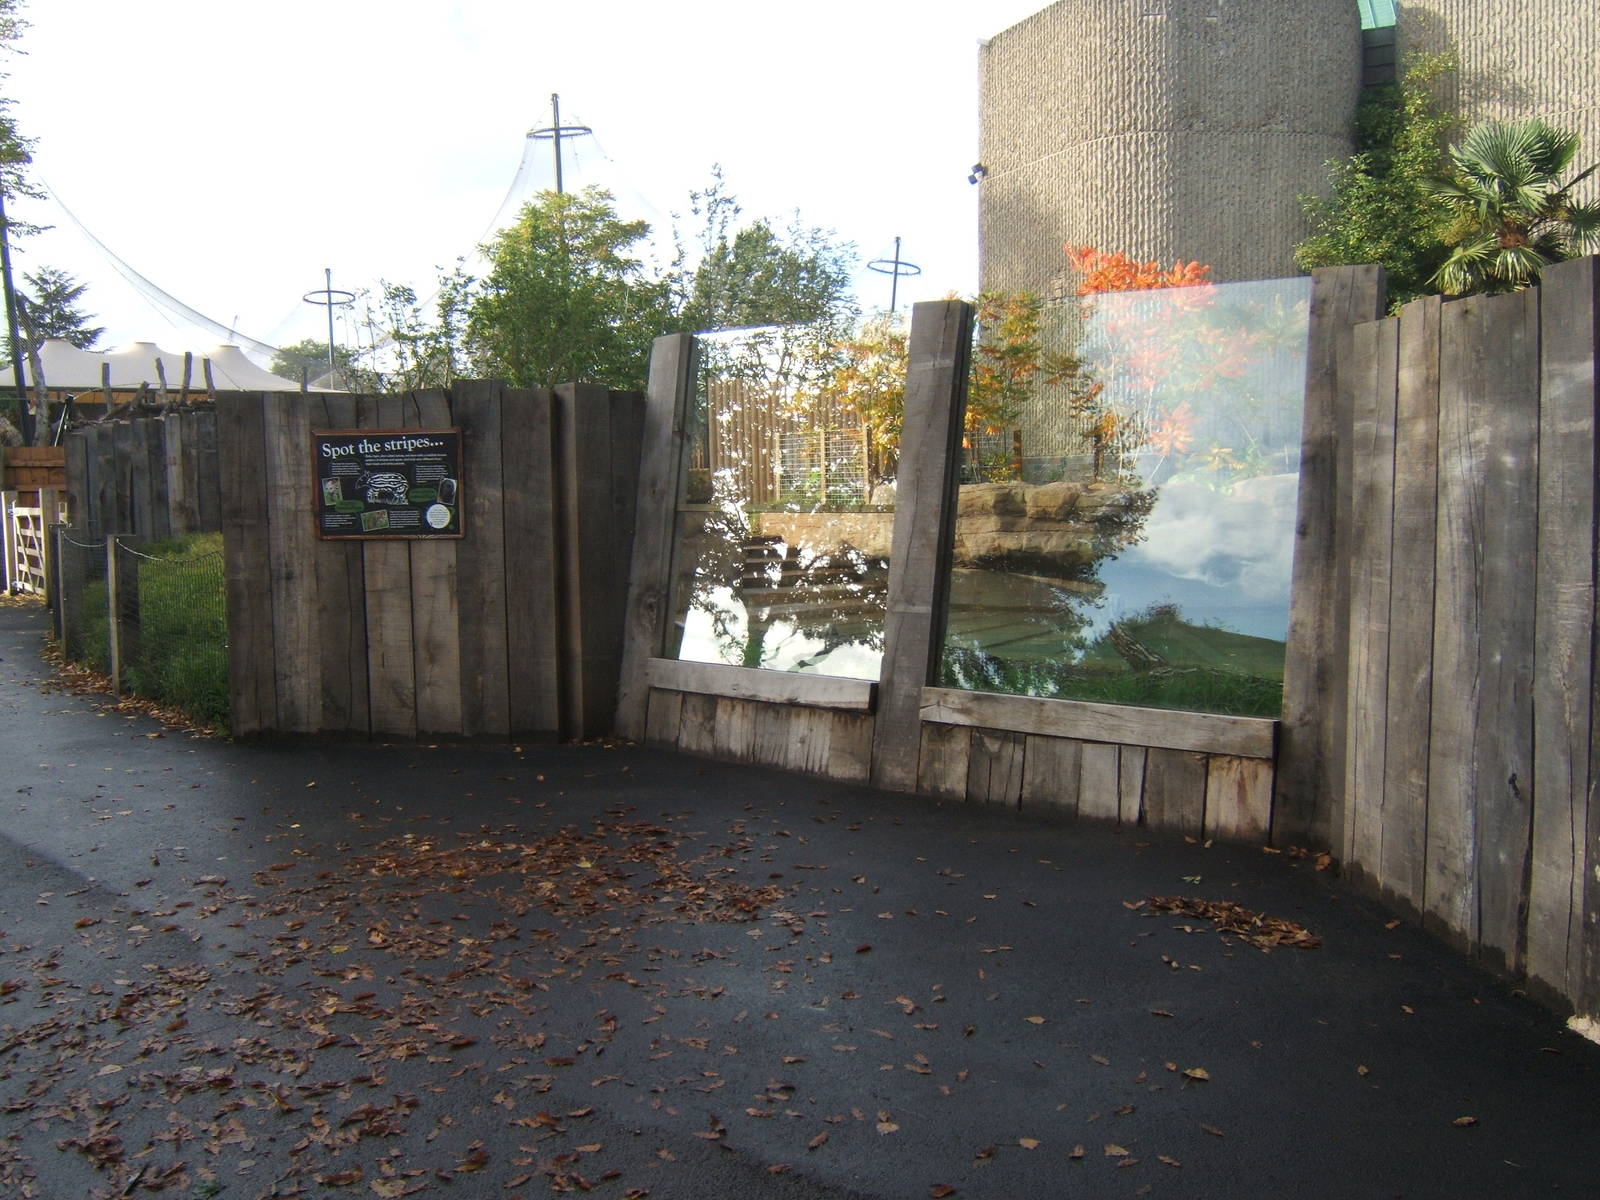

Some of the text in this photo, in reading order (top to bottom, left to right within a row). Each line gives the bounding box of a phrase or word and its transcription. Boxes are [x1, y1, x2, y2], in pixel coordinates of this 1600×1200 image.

[322, 443, 355, 459] Spot
[359, 439, 381, 454] the
[384, 436, 444, 452] stripes...
